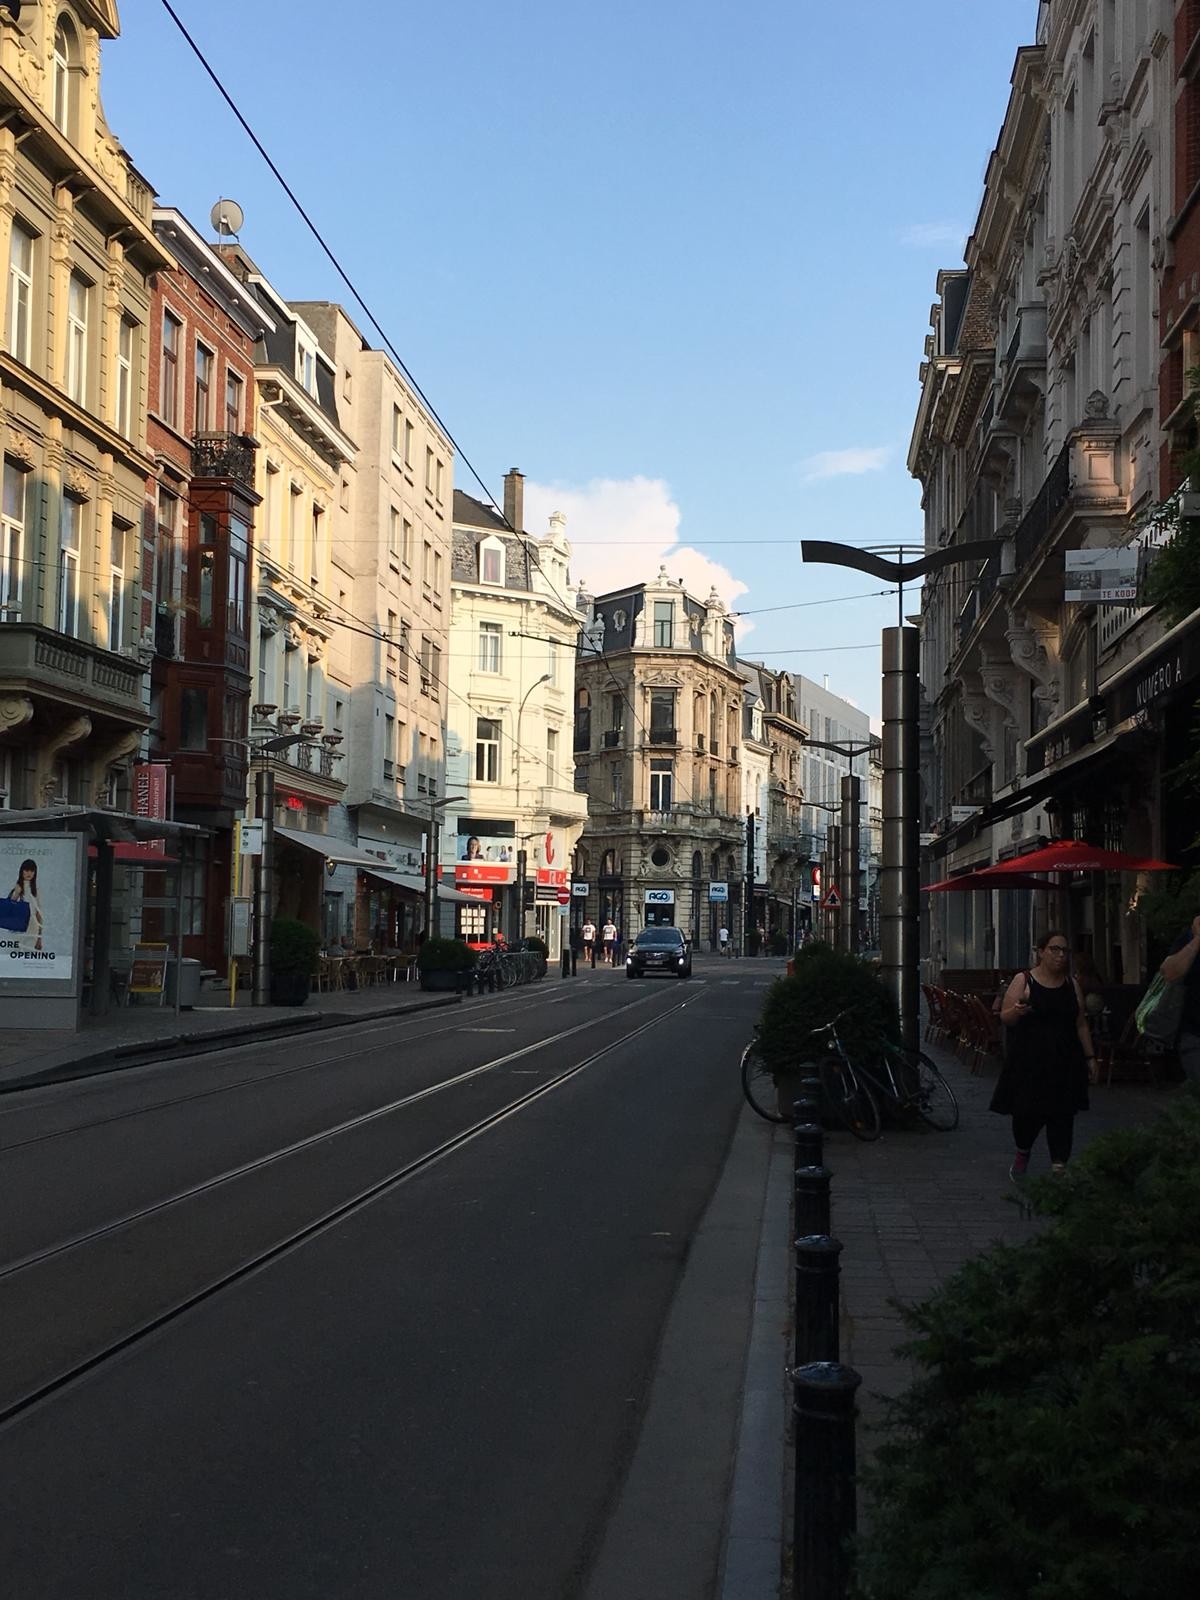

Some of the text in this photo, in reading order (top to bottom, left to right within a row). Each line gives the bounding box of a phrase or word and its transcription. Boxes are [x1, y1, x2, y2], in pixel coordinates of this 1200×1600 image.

[1103, 589, 1136, 598] TE KOOP
[649, 891, 670, 902] AGO
[10, 951, 56, 960] OPENING
